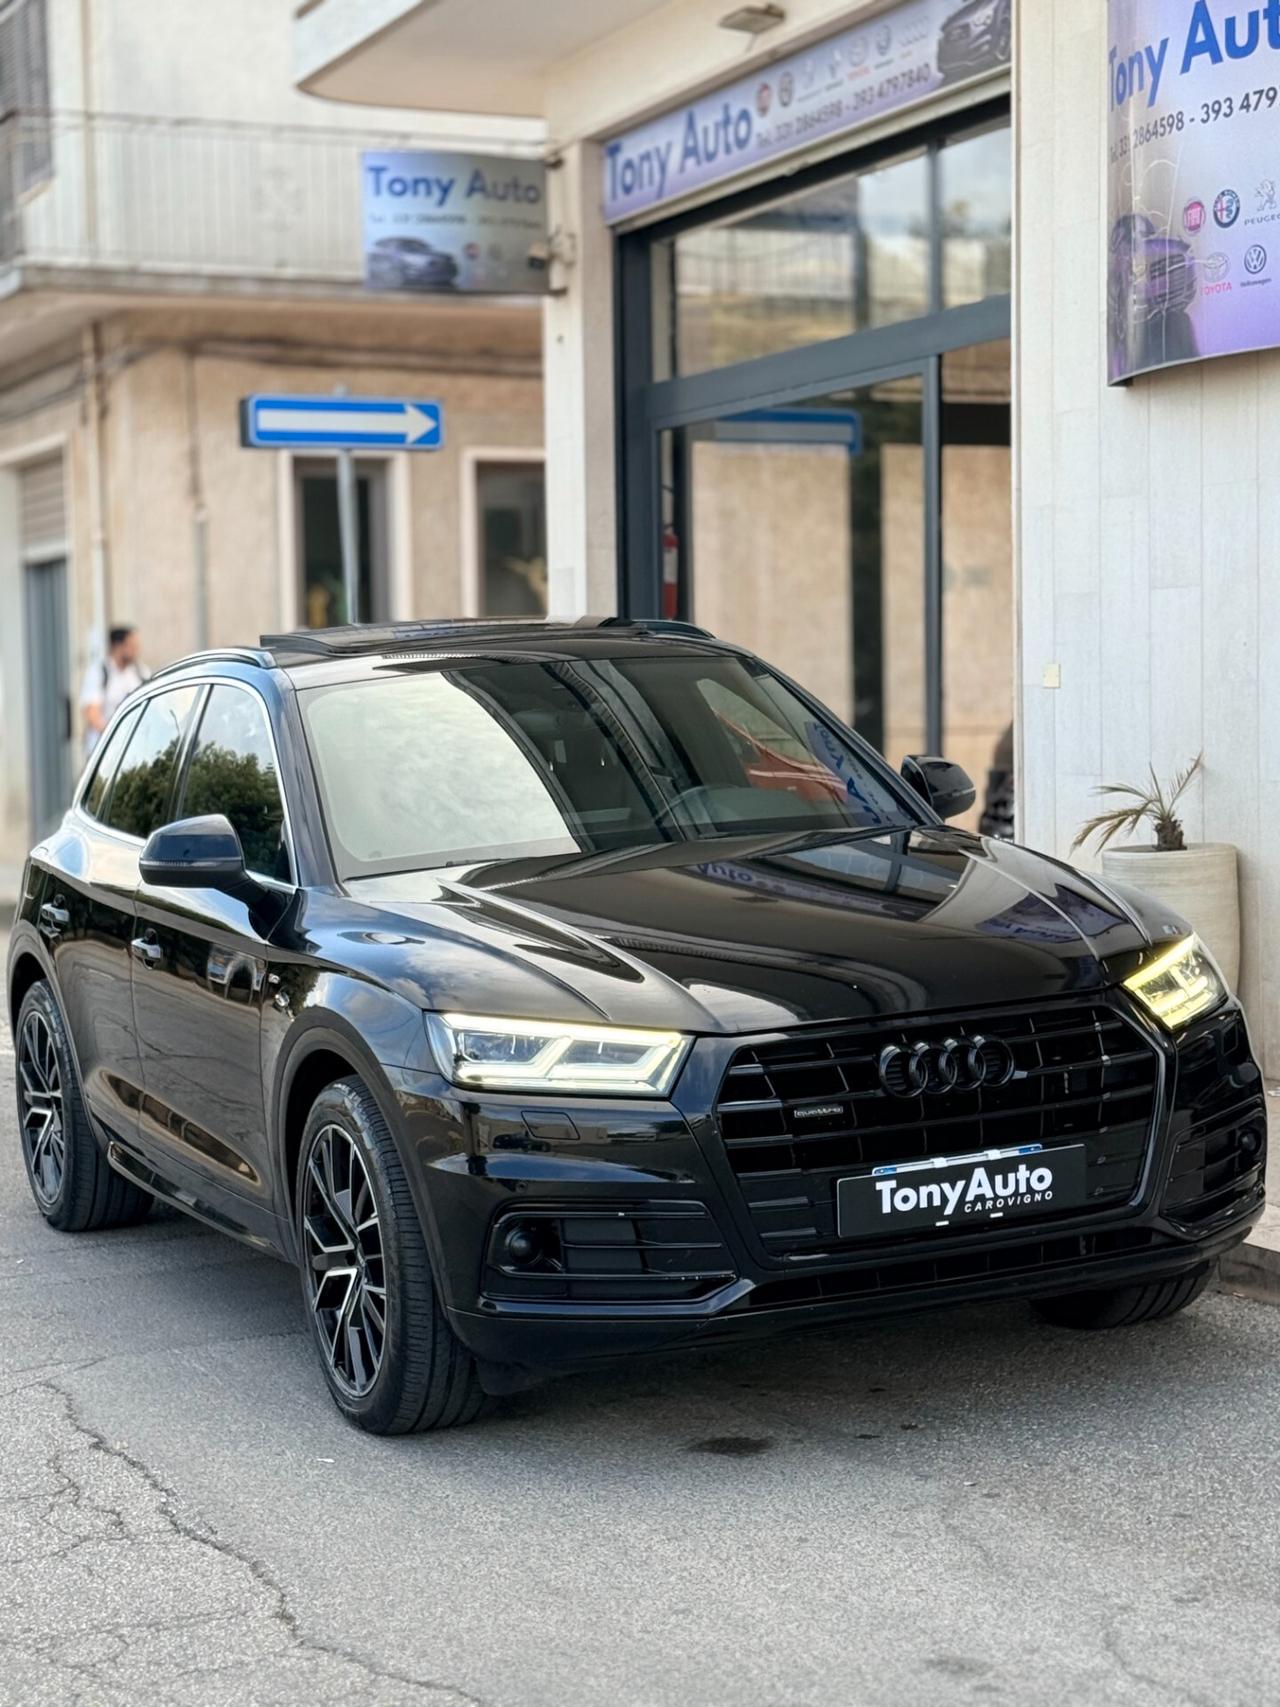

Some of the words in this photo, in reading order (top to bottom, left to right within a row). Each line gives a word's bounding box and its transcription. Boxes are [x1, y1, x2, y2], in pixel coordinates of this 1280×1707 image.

[1108, 37, 1170, 112] Tony
[1132, 111, 1185, 149] 2864598
[1201, 97, 1234, 124] 393
[1239, 86, 1280, 113] 479
[605, 140, 672, 200] Tony
[679, 103, 752, 174] Auto
[368, 165, 456, 207] Tony
[465, 168, 541, 204] Auto
[875, 1164, 1053, 1216] TonyAuto
[964, 1190, 1053, 1213] CAROVIGNO
